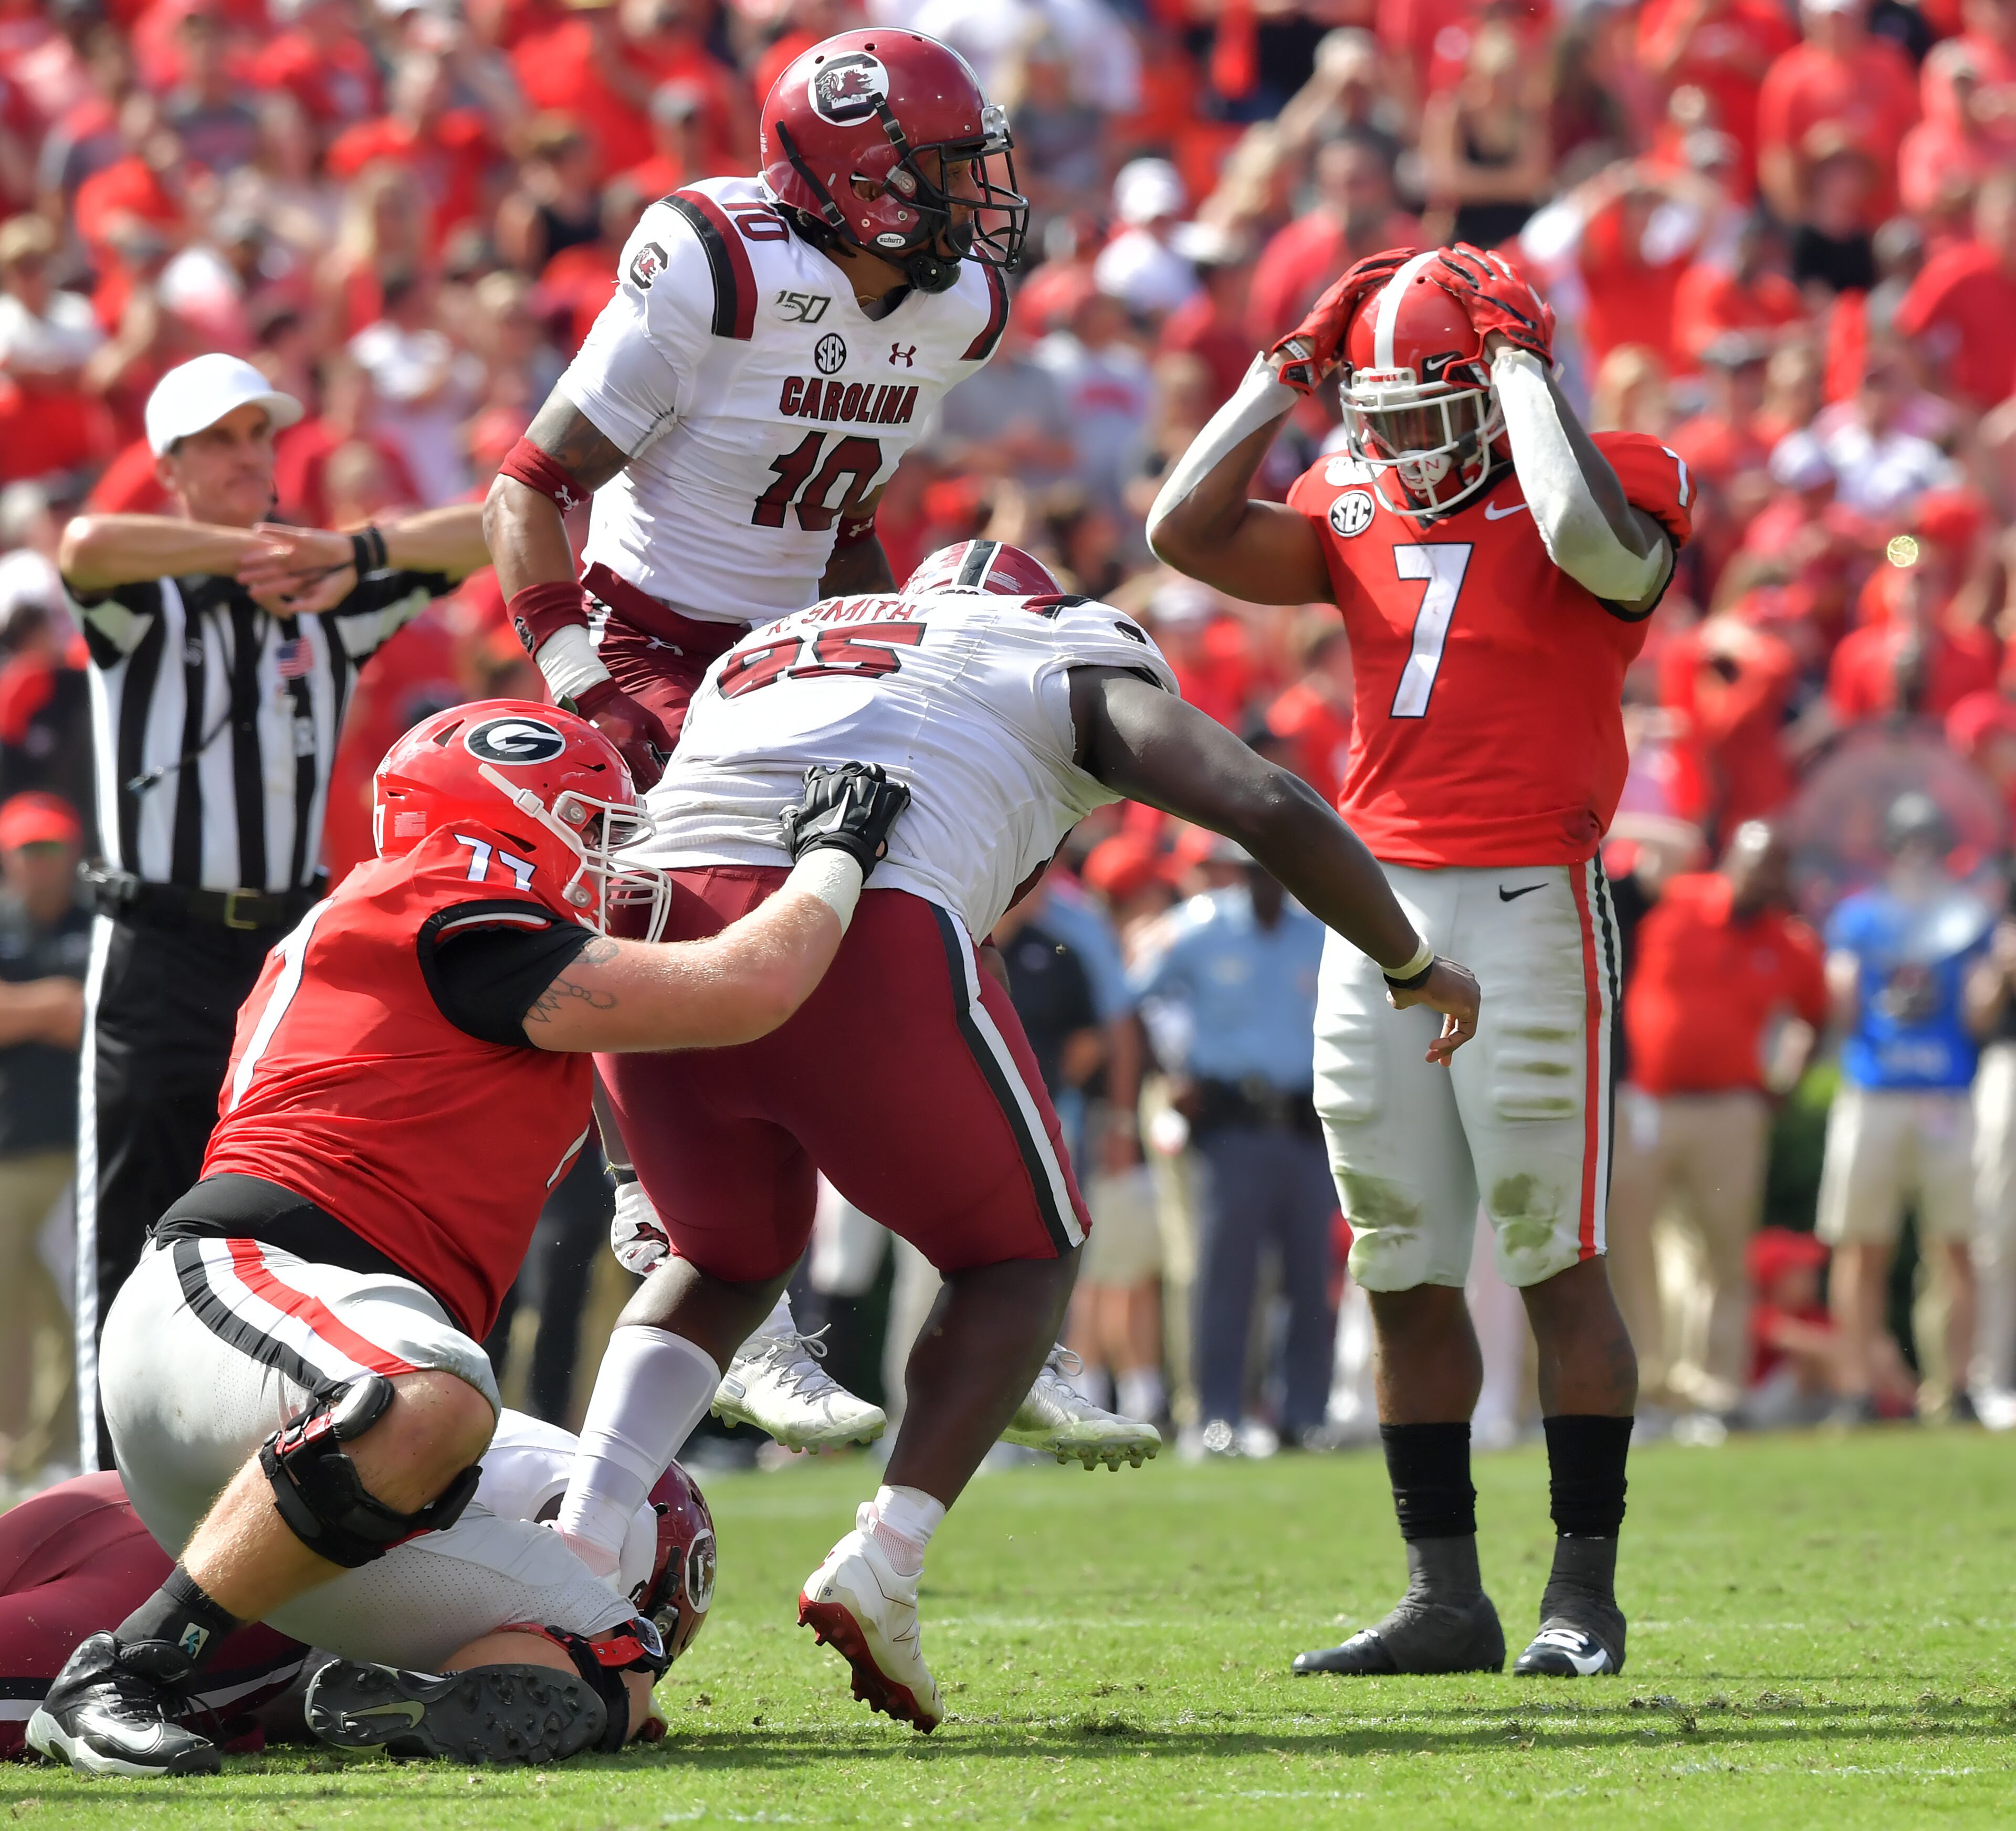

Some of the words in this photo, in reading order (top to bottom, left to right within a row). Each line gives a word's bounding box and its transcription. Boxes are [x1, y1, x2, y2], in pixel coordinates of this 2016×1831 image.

[775, 290, 832, 323] 150
[817, 335, 845, 372] SEC
[779, 376, 919, 424] CAROLINA
[751, 430, 883, 531] 10
[1332, 494, 1371, 532] SEC
[801, 598, 918, 624] SMITH
[1390, 542, 1474, 719] 7
[717, 622, 927, 700] 95
[453, 833, 536, 892] 77
[823, 1587, 833, 1596] 95
